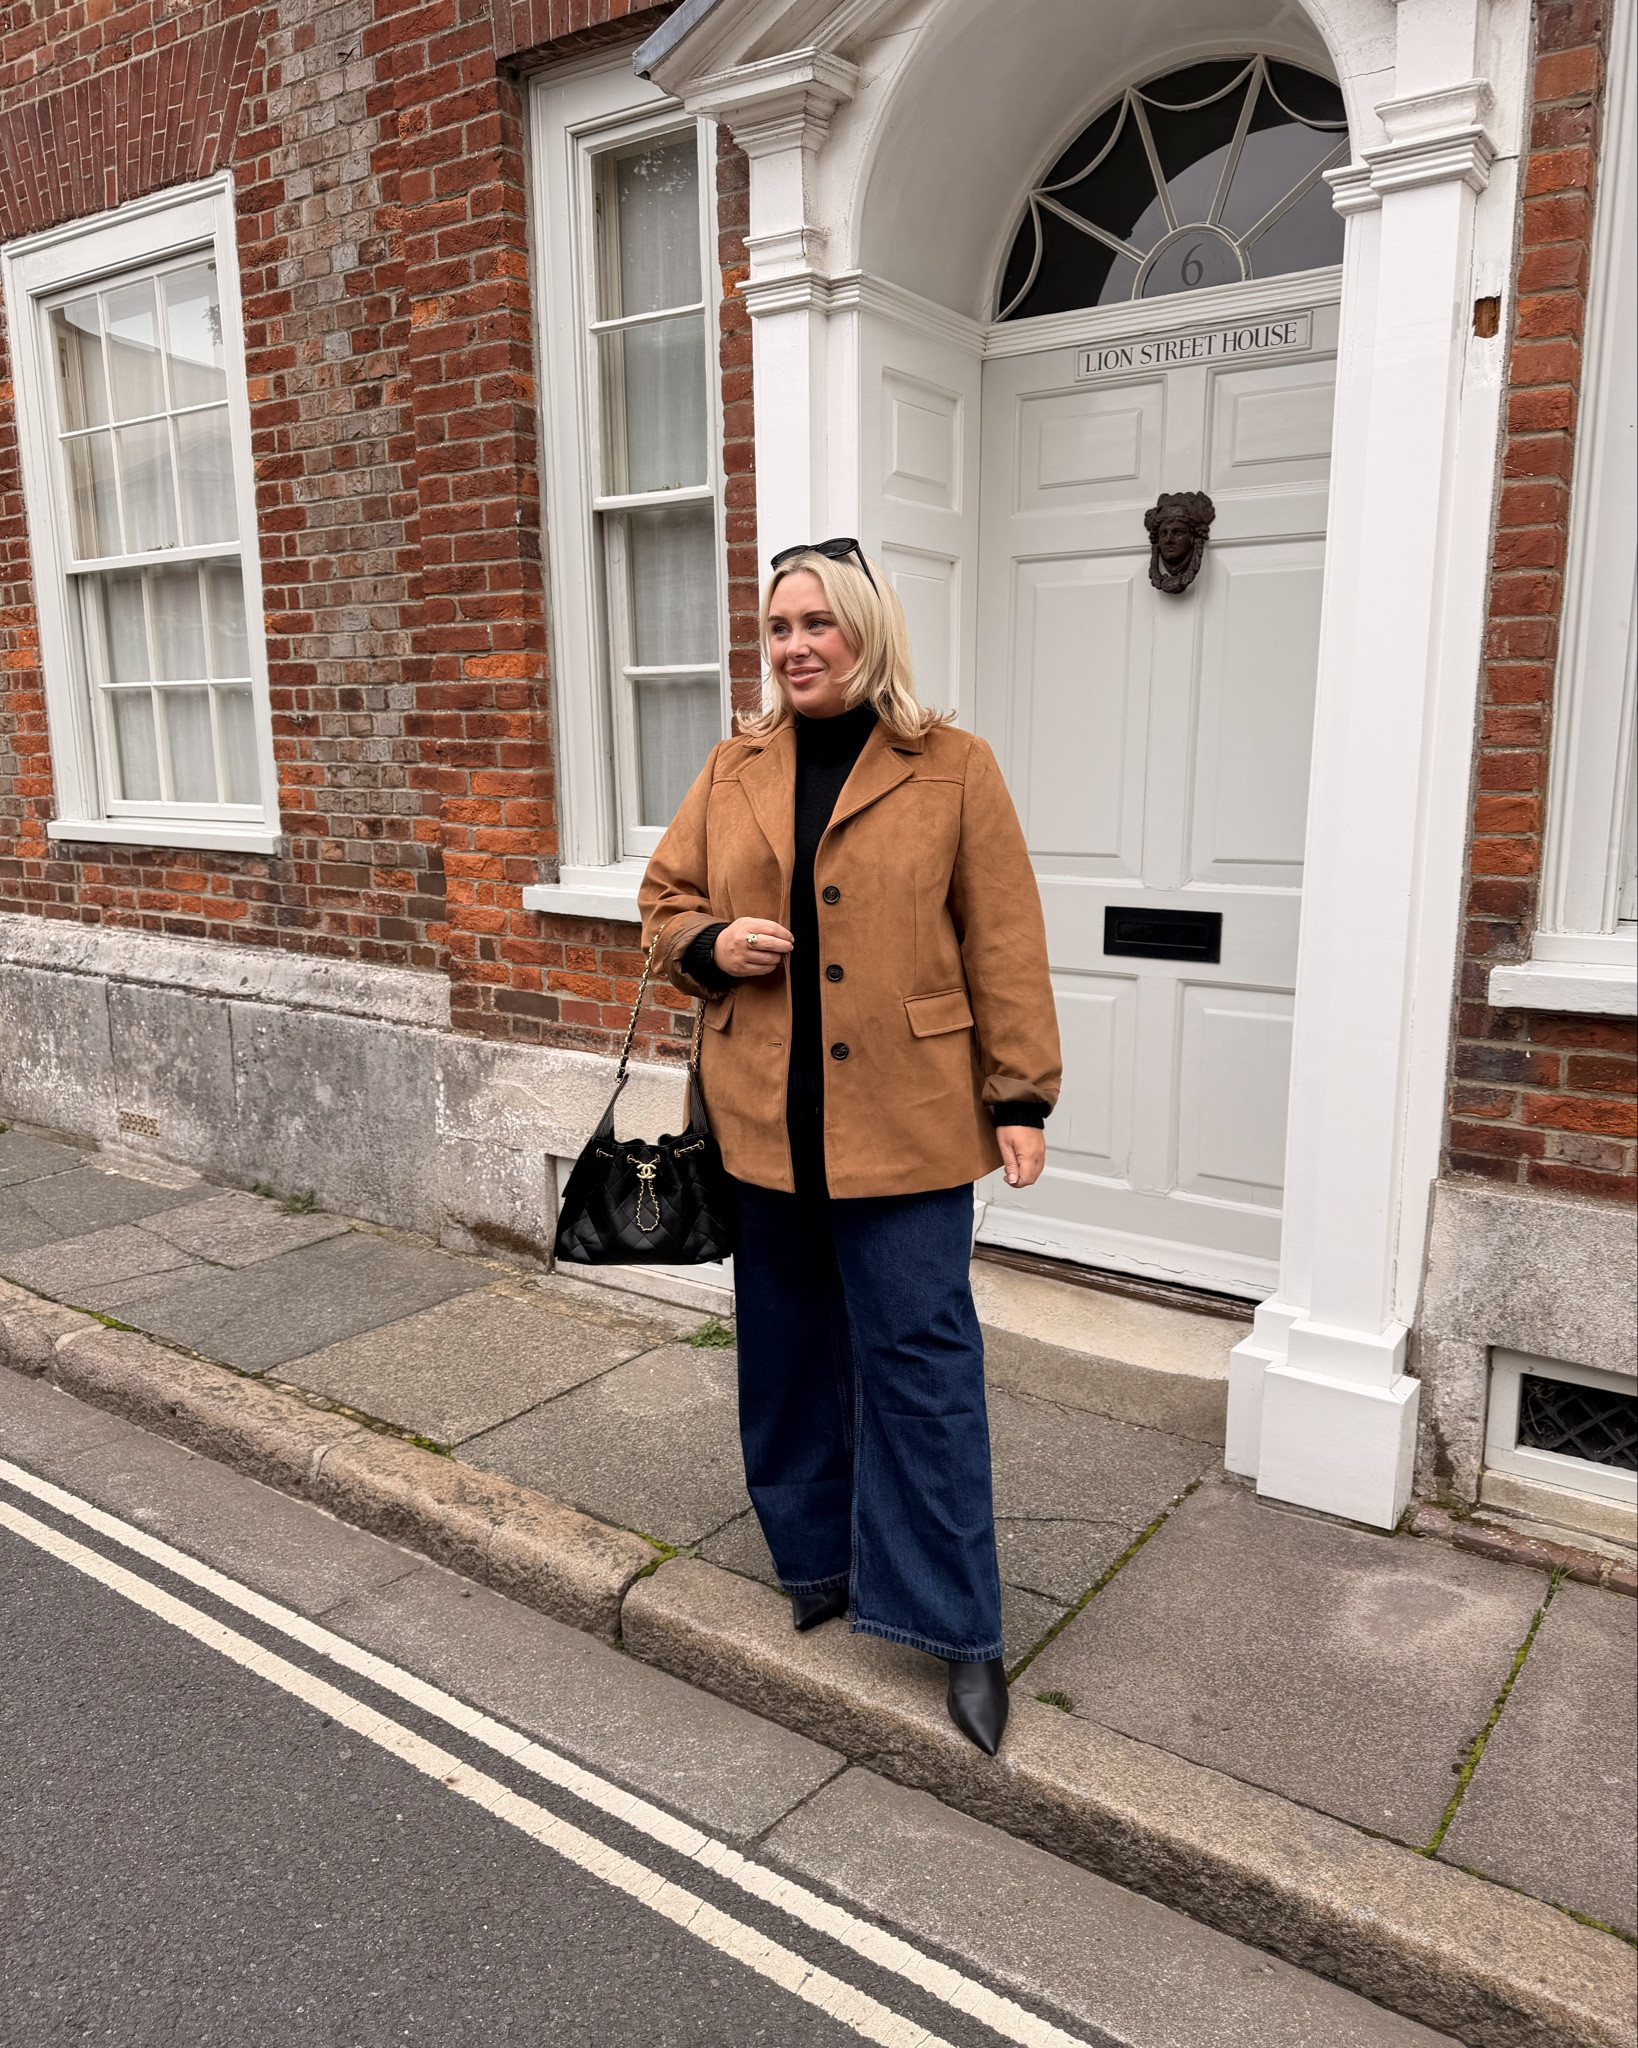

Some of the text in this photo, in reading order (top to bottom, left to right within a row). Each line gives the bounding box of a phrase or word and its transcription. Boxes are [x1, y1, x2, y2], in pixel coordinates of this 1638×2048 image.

[1181, 243, 1204, 286] 6
[1085, 321, 1298, 373] LION STREET HOUSE
